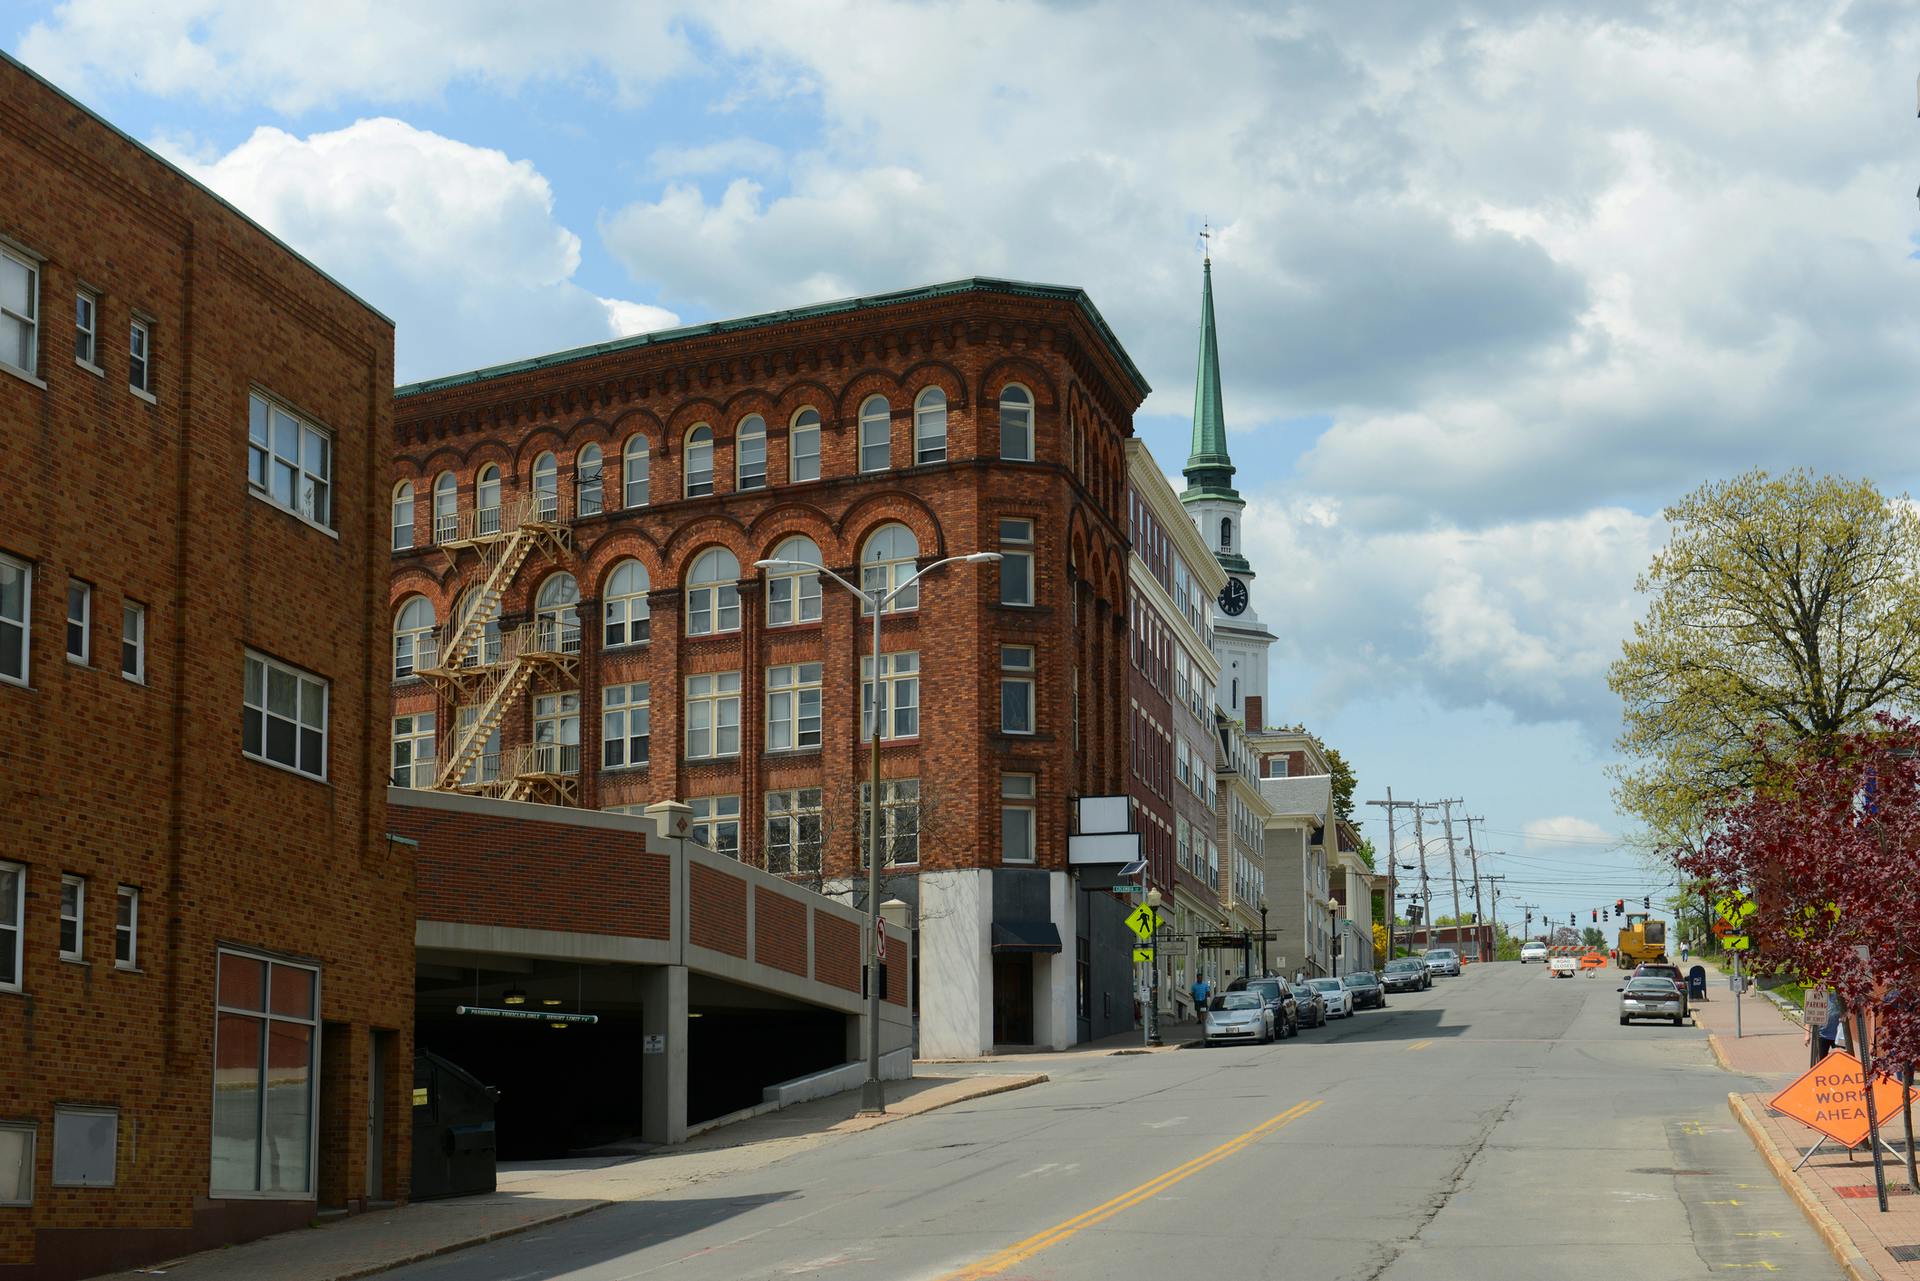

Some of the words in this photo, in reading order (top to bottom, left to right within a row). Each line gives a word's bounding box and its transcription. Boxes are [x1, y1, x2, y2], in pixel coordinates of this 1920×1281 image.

[1815, 1072, 1865, 1087] ROAD
[1816, 1090, 1867, 1104] WORK
[1816, 1108, 1877, 1121] AHEA
